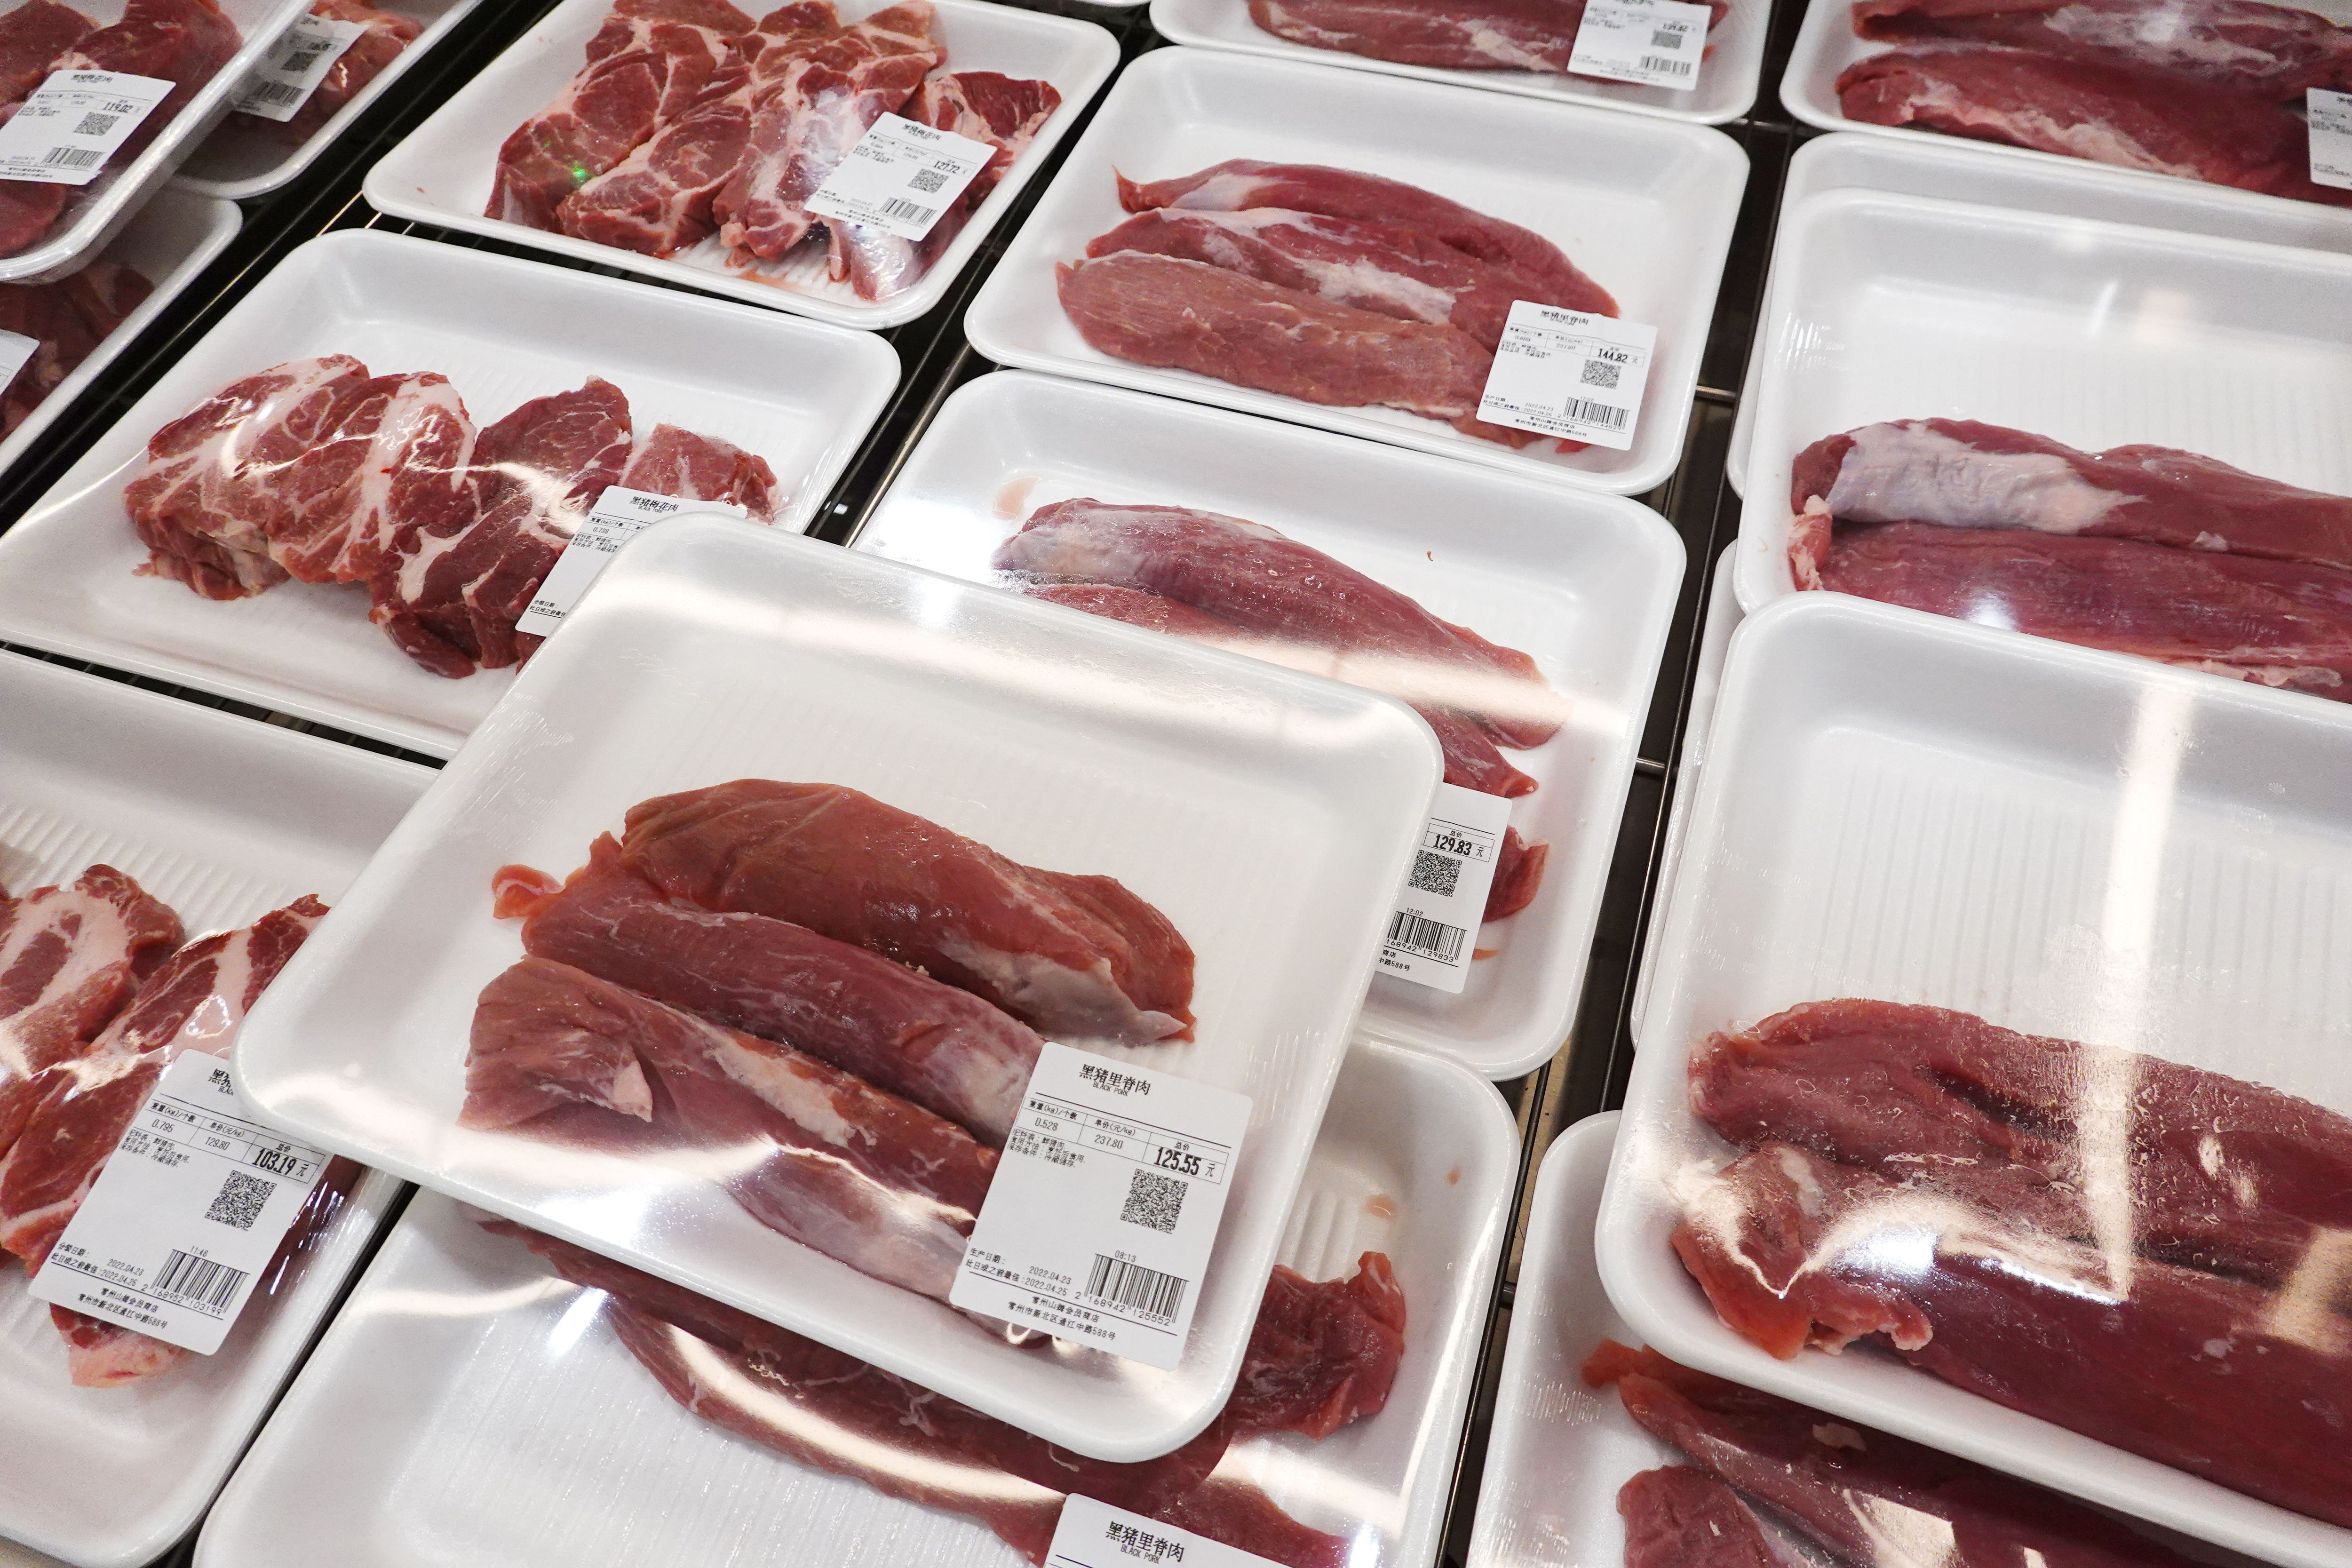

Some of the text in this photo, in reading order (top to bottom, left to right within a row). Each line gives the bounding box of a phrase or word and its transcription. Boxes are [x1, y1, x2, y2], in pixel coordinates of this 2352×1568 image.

[1598, 348, 1628, 363] 144.82
[629, 496, 679, 512] 黑猪梅花肉
[1433, 834, 1484, 857] 129.83 元
[1406, 907, 1423, 917] 12:02
[1387, 939, 1454, 962] 168942 129833
[1079, 1064, 1151, 1095] 黑猪里脊肉
[1093, 1082, 1130, 1097] BLACK PORK
[1094, 1119, 1136, 1137] 单价(元/kg)
[1174, 1141, 1190, 1151] 总价
[151, 1119, 310, 1177] 0.795 129.80 103.19 元
[1035, 1117, 1215, 1177] 0.528 237.80 125.55 元
[190, 1246, 208, 1257] 11:46
[1114, 1250, 1137, 1263] 08:13
[1029, 1266, 1072, 1285] 2022.04.23
[153, 1289, 184, 1304] 168952
[189, 1300, 222, 1315] 103199
[1089, 1296, 1126, 1313] 168942
[1133, 1308, 1170, 1326] 125552
[1105, 1520, 1184, 1562] 黑猪里脊肉
[1120, 1544, 1160, 1564] BLACK PORK
